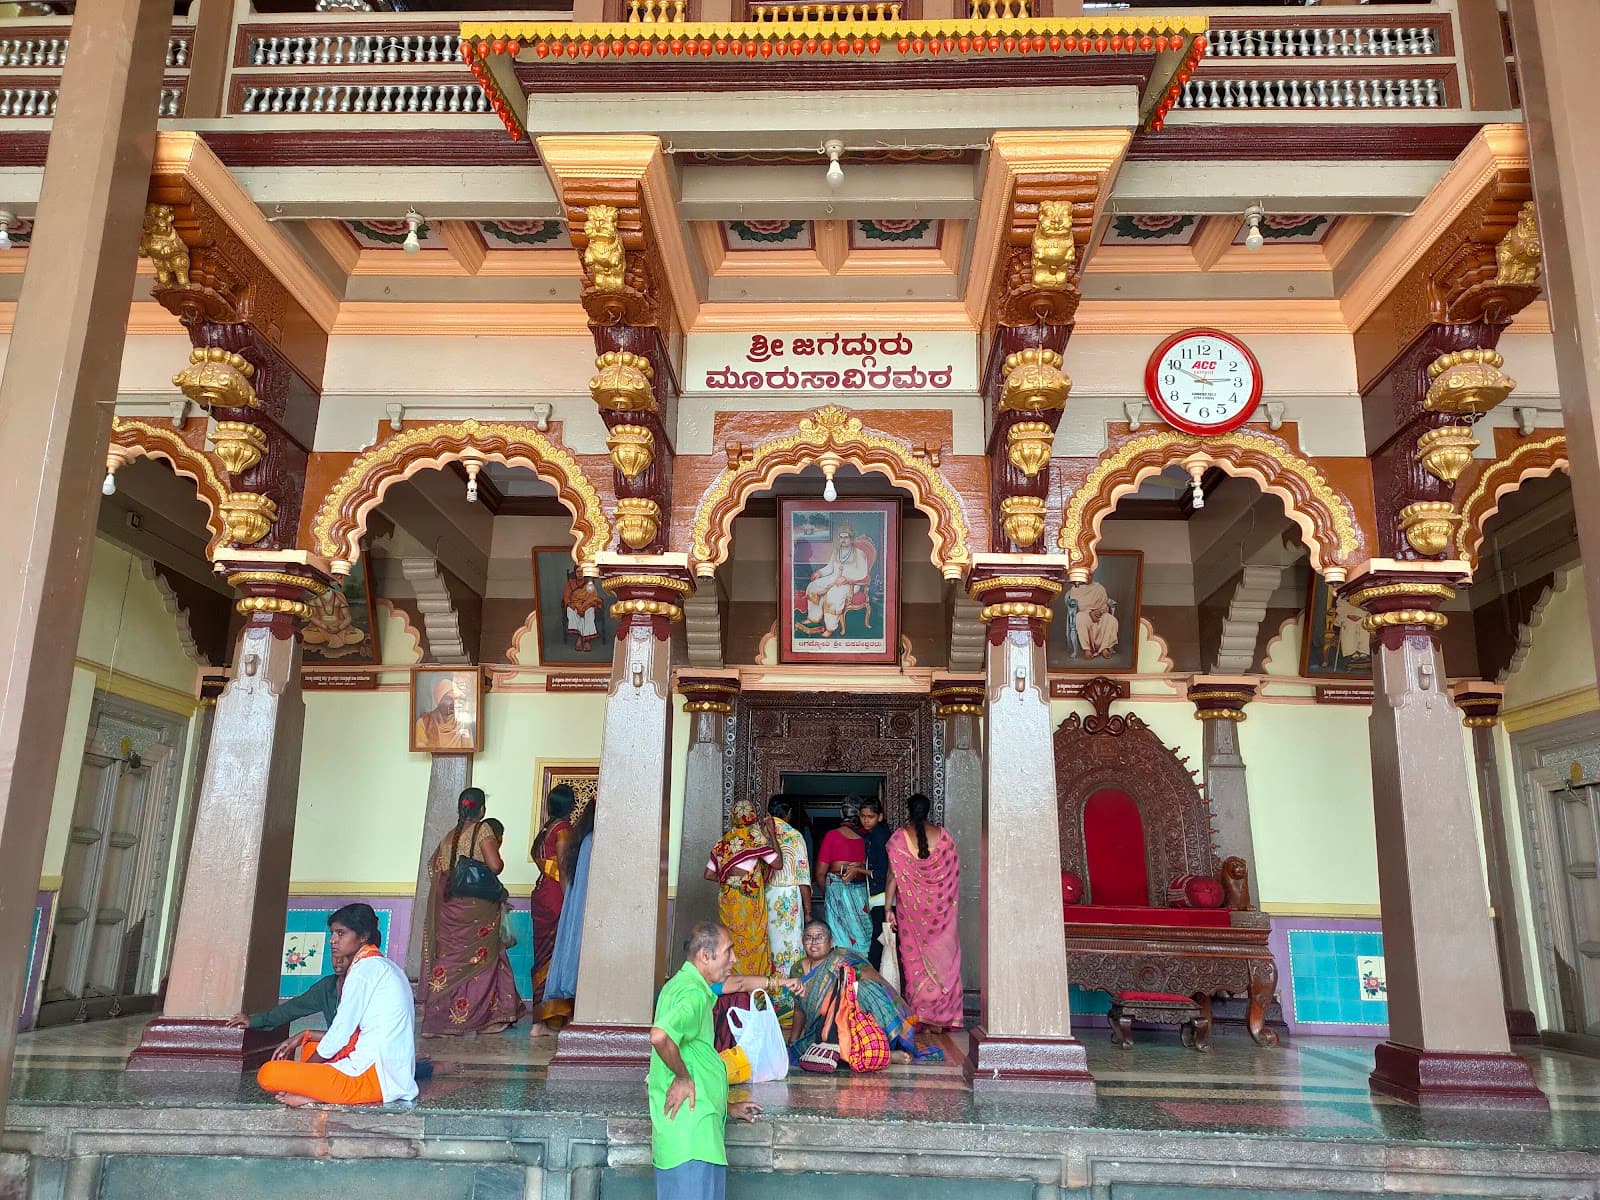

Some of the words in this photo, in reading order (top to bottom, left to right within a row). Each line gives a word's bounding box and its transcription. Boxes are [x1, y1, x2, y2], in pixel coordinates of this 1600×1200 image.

[746, 334, 784, 363] ಶ್ರೀ
[792, 333, 913, 368] ಜಗದ್ಗುರು
[1181, 348, 1192, 359] 11
[1198, 344, 1211, 355] 12
[1218, 349, 1223, 360] 1
[1168, 359, 1182, 370] 10
[1192, 360, 1217, 370] ACC
[1229, 361, 1238, 372] 2
[705, 365, 953, 389] ಮೂರುಸಾವಿರಮಠ
[1164, 375, 1175, 385] 9
[1233, 377, 1243, 388] 3
[1170, 390, 1179, 401] 8
[1228, 392, 1237, 403] 4
[1182, 402, 1192, 413] 7
[1199, 407, 1210, 418] 6
[1216, 404, 1227, 415] 5
